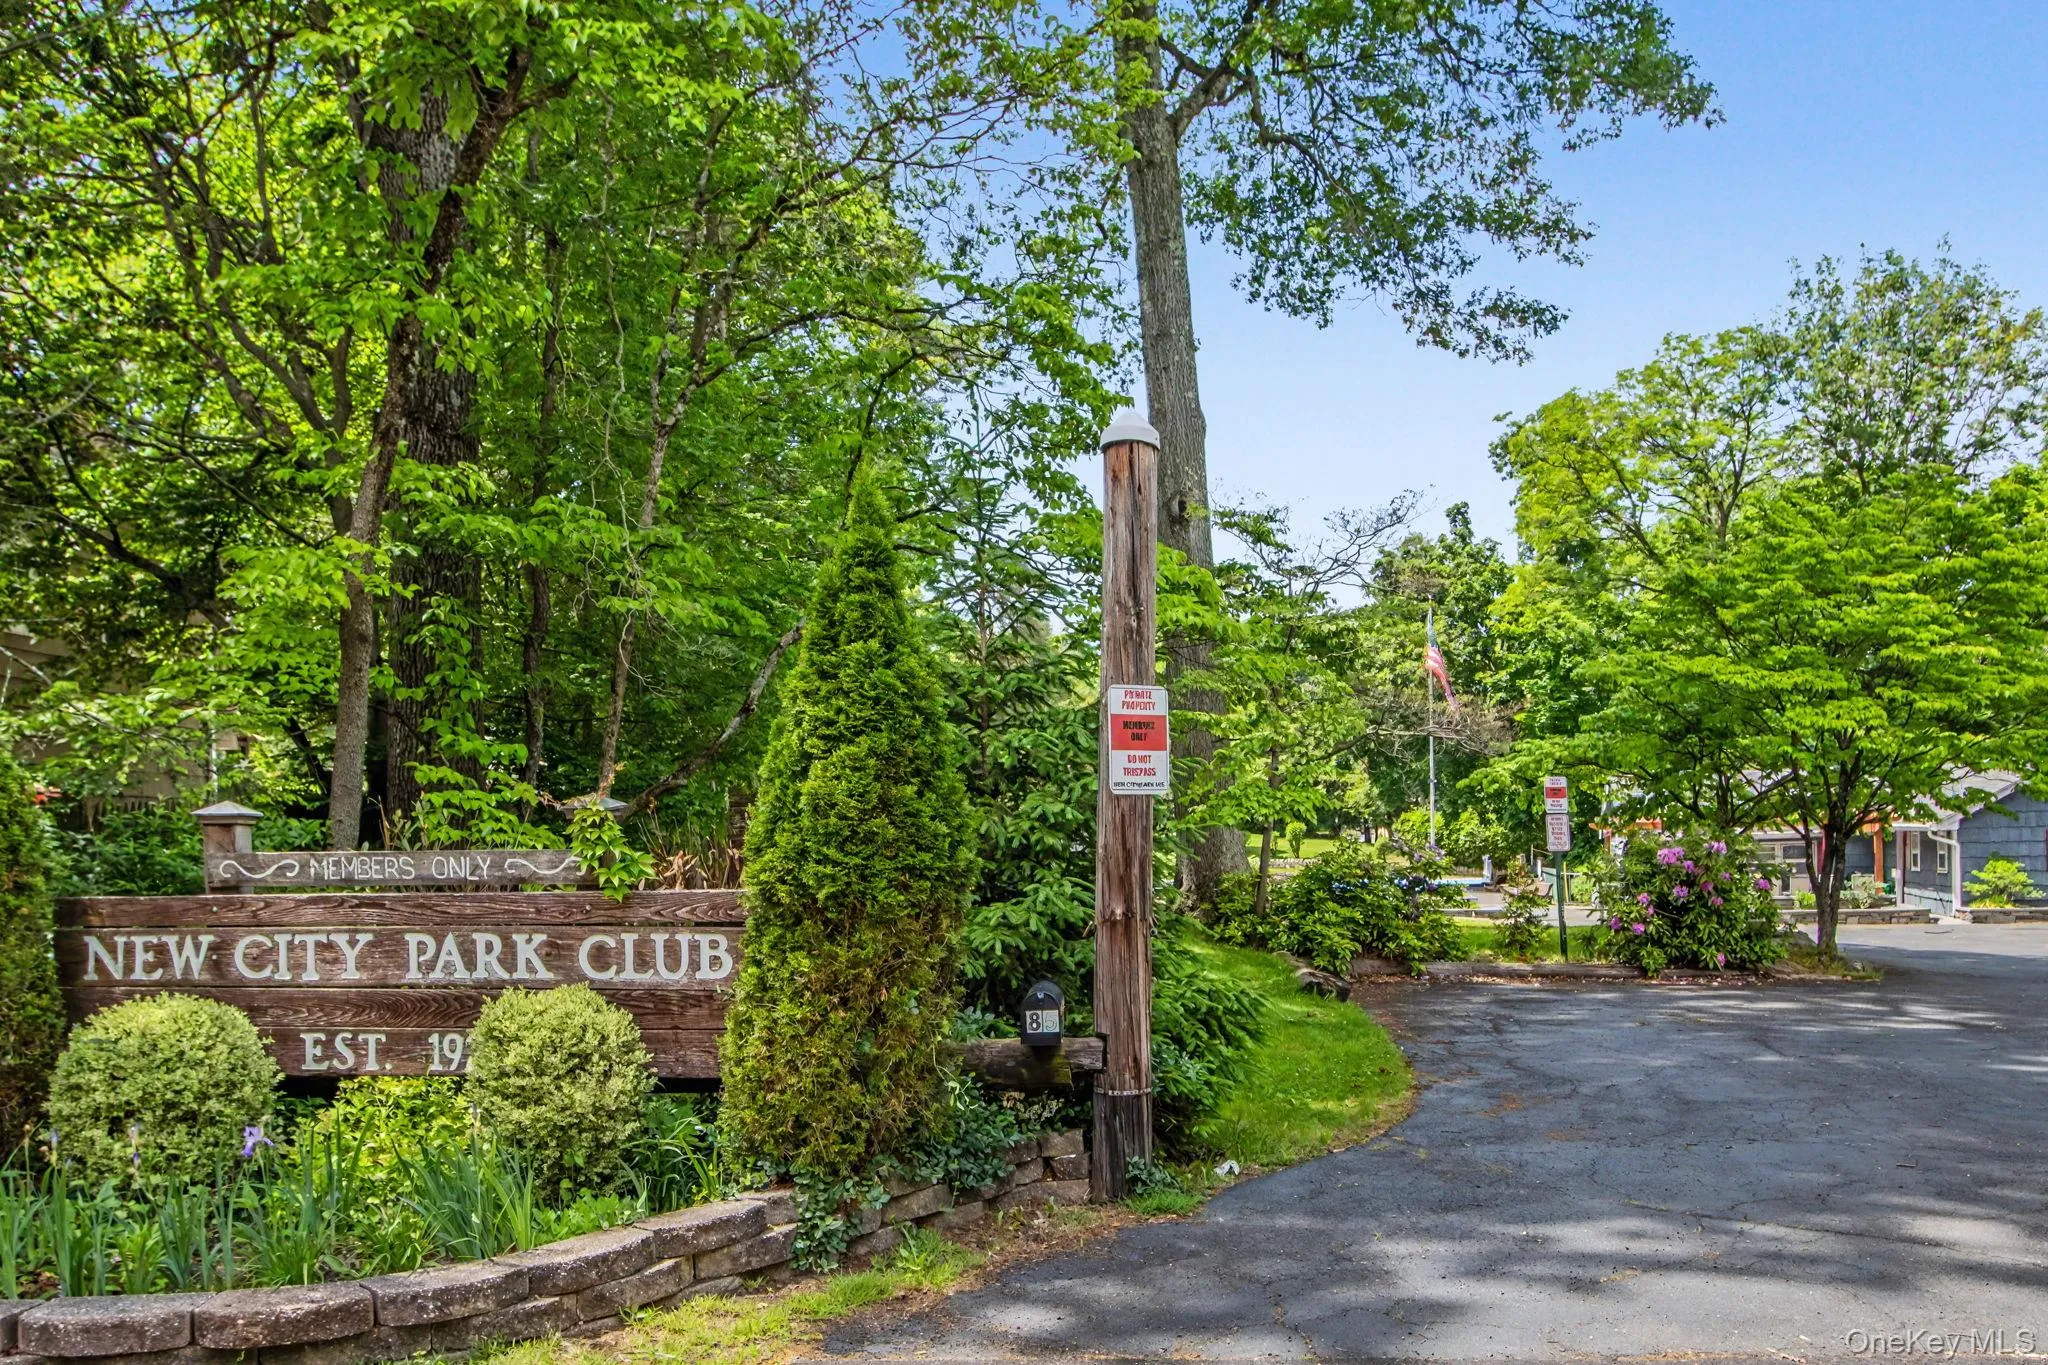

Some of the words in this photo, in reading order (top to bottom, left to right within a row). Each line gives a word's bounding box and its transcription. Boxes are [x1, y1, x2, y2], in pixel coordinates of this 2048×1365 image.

[1121, 700, 1156, 711] PROPERTY
[1127, 754, 1136, 764] DO
[1138, 754, 1152, 764] NOT
[1123, 767, 1157, 777] TRESPASS
[309, 856, 416, 881] MEMBERS
[431, 856, 491, 881] ONLY
[83, 934, 216, 981] NEW
[233, 933, 374, 981] CITY
[403, 932, 555, 980] PARK
[578, 932, 734, 980] CLUB
[1028, 1011, 1058, 1032] 85
[300, 1032, 394, 1071] EST.
[428, 1032, 472, 1071] 19
